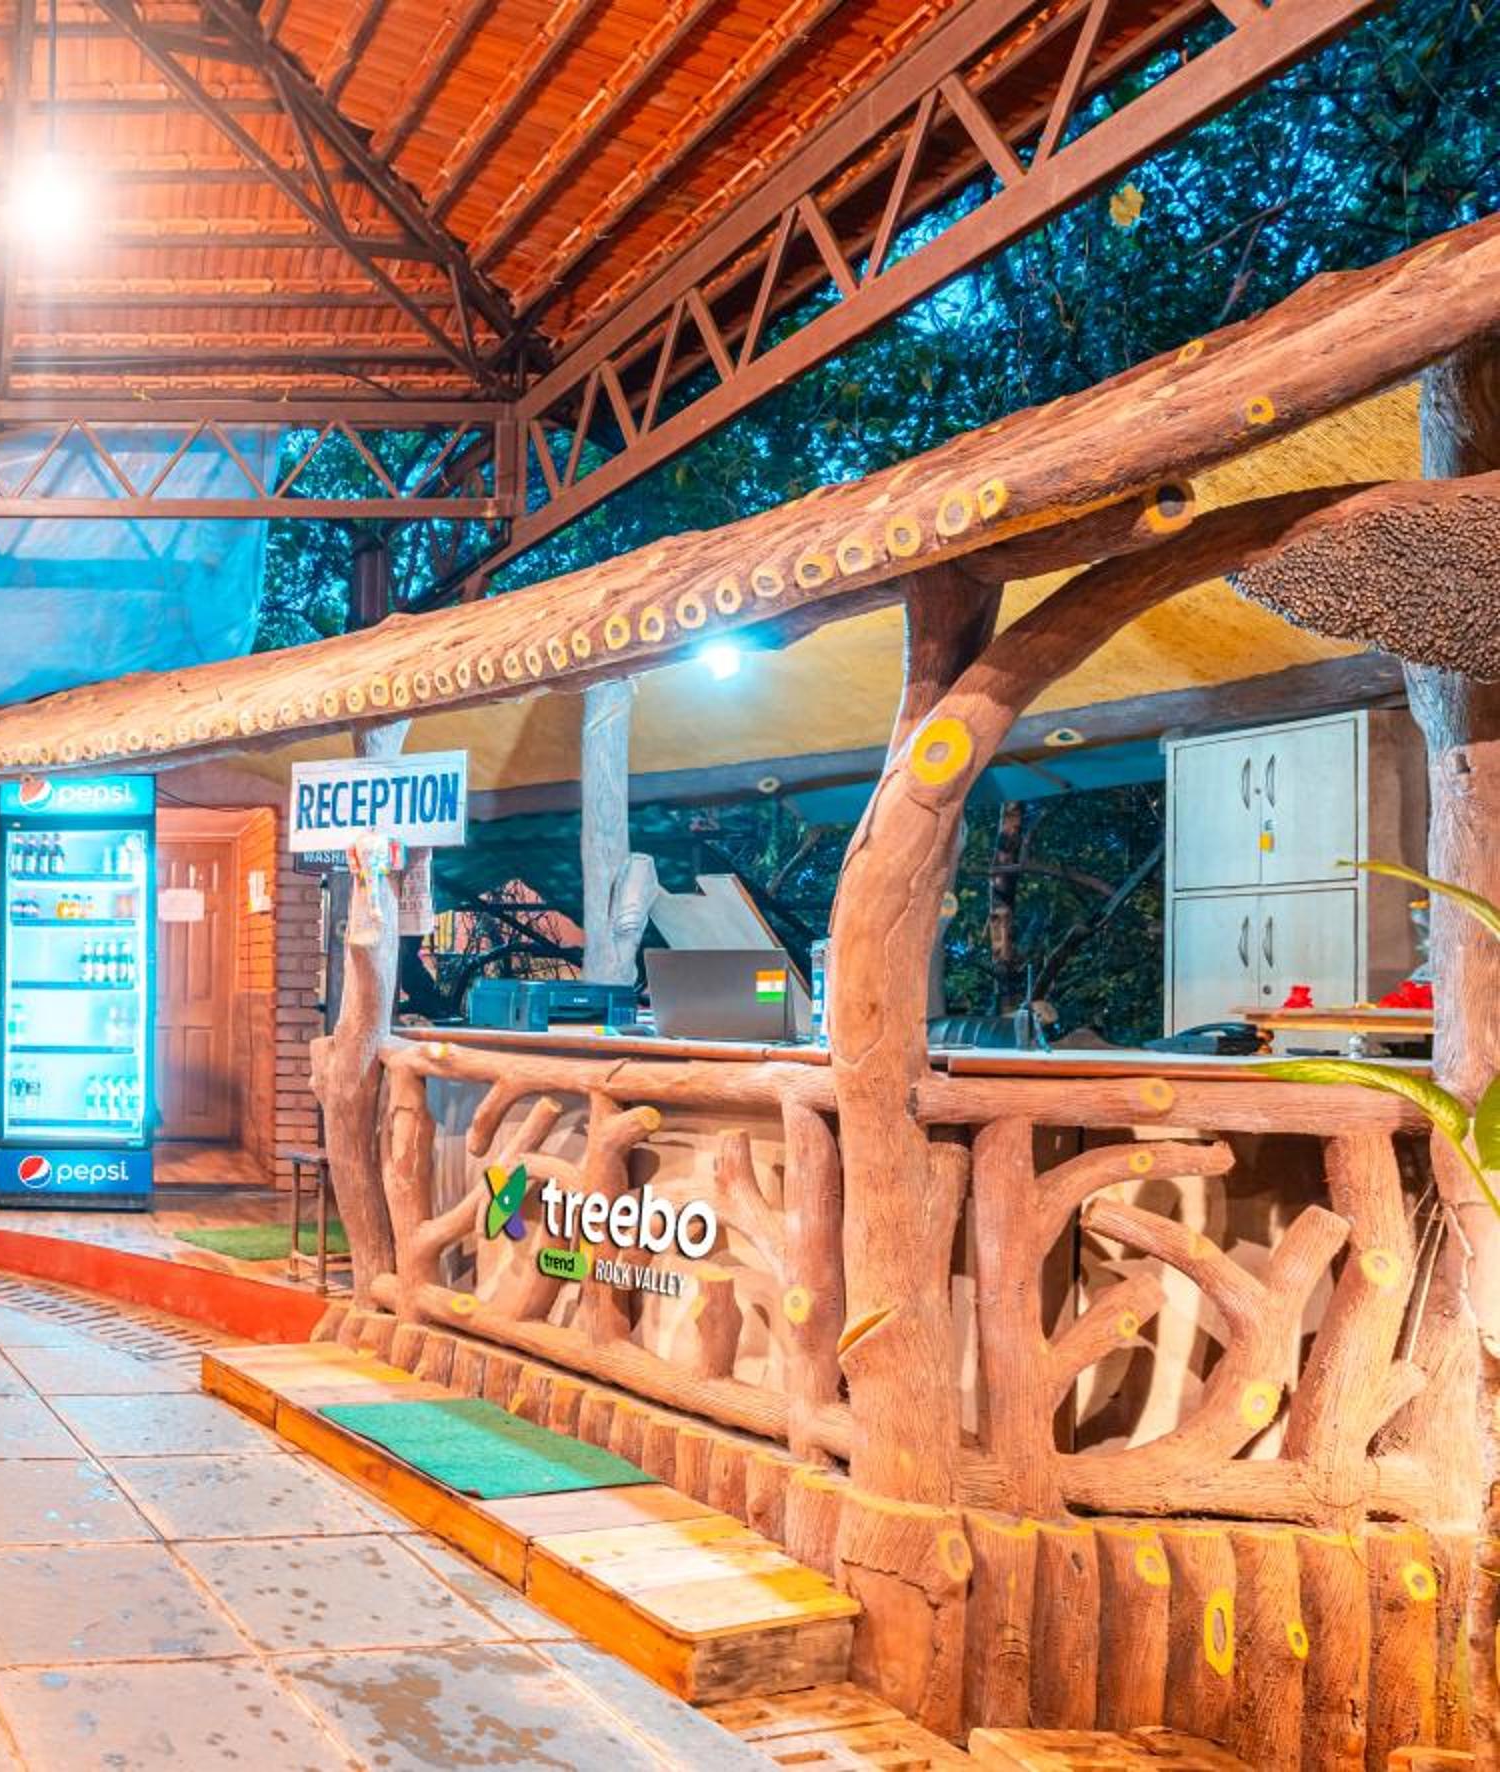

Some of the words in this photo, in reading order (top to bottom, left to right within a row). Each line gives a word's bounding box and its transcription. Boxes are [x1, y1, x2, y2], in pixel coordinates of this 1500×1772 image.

[57, 782, 132, 806] pepsi
[297, 773, 459, 830] RECEPTION
[57, 1160, 127, 1185] pepsi
[542, 1177, 717, 1259] treebo
[543, 1253, 575, 1272] trend
[595, 1260, 632, 1285] ROCK
[635, 1265, 685, 1297] VALLEY
